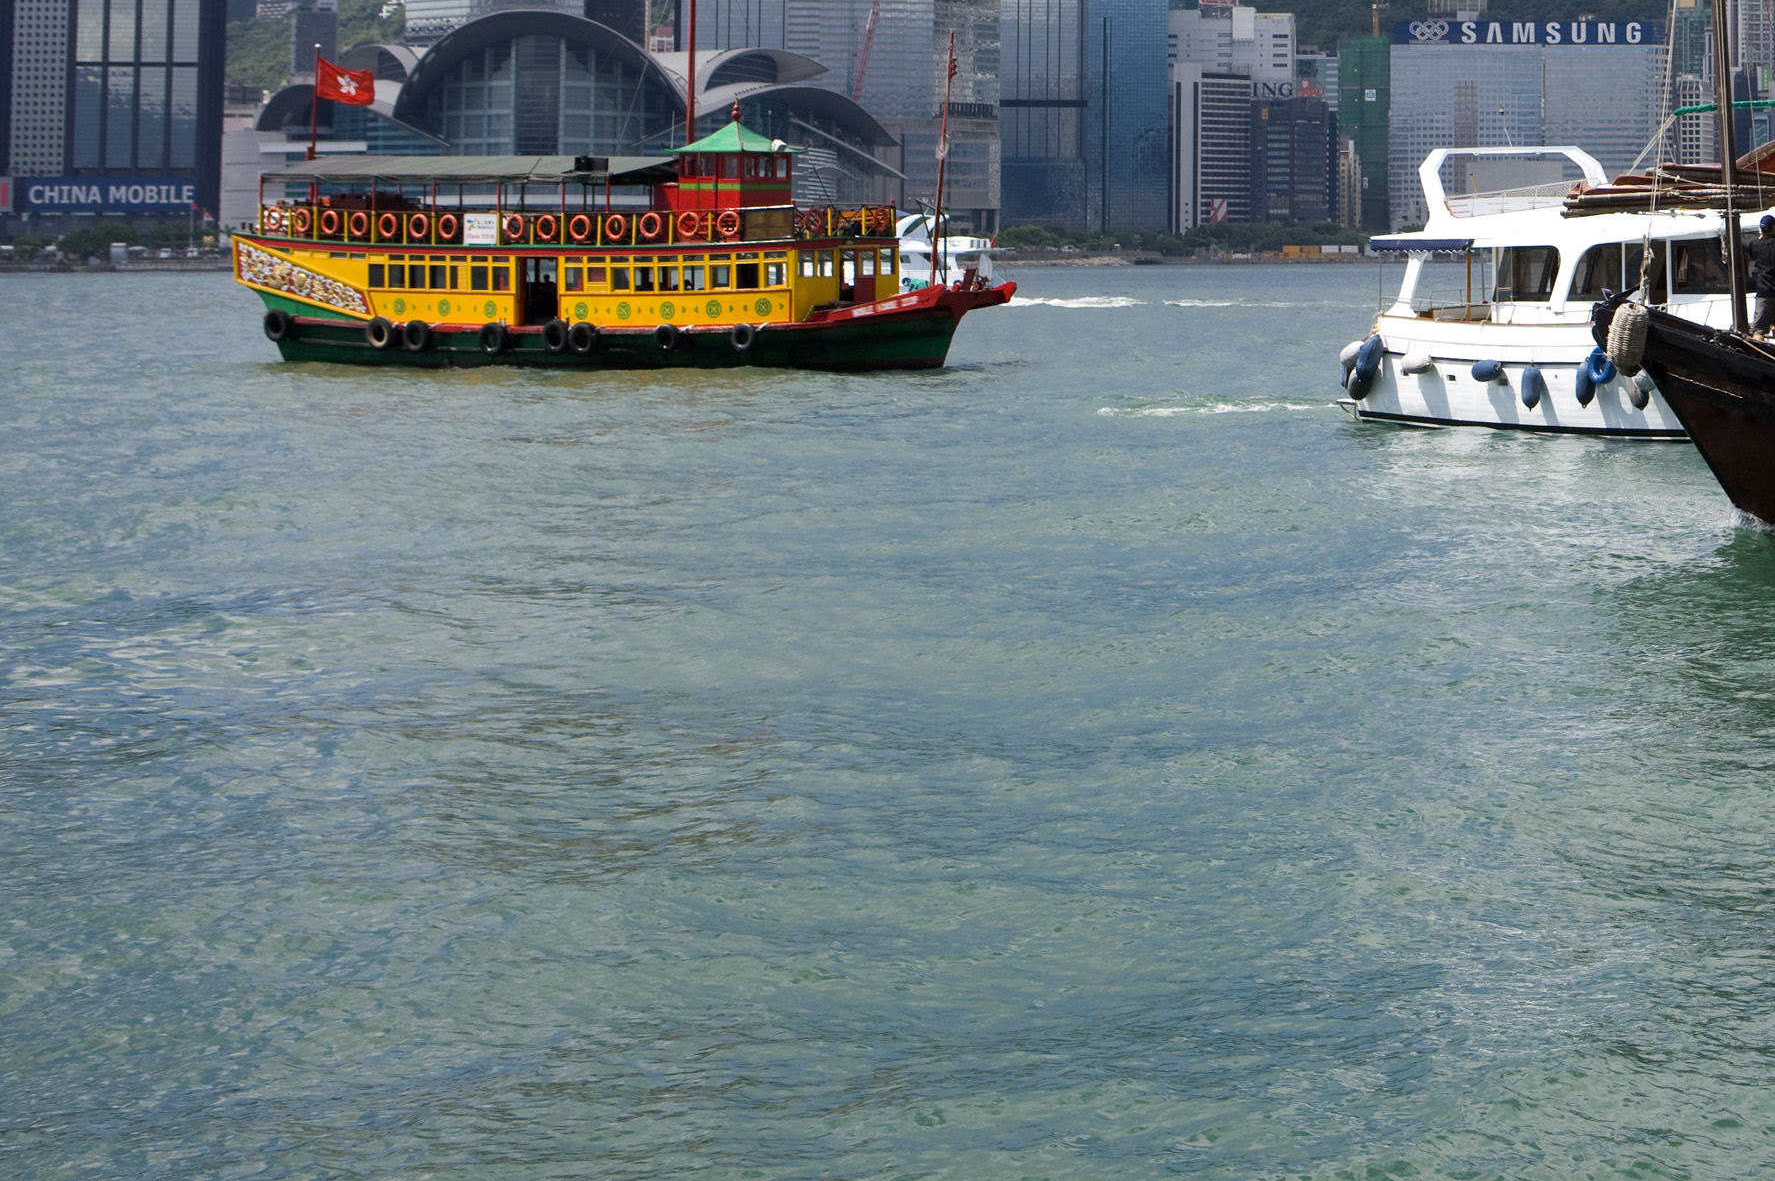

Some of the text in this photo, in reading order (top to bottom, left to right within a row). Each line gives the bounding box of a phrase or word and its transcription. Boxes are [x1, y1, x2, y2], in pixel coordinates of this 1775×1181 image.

[1461, 22, 1642, 44] SAMSUNG
[1252, 82, 1293, 98] ING
[29, 185, 194, 203] CHINA MOBILE
